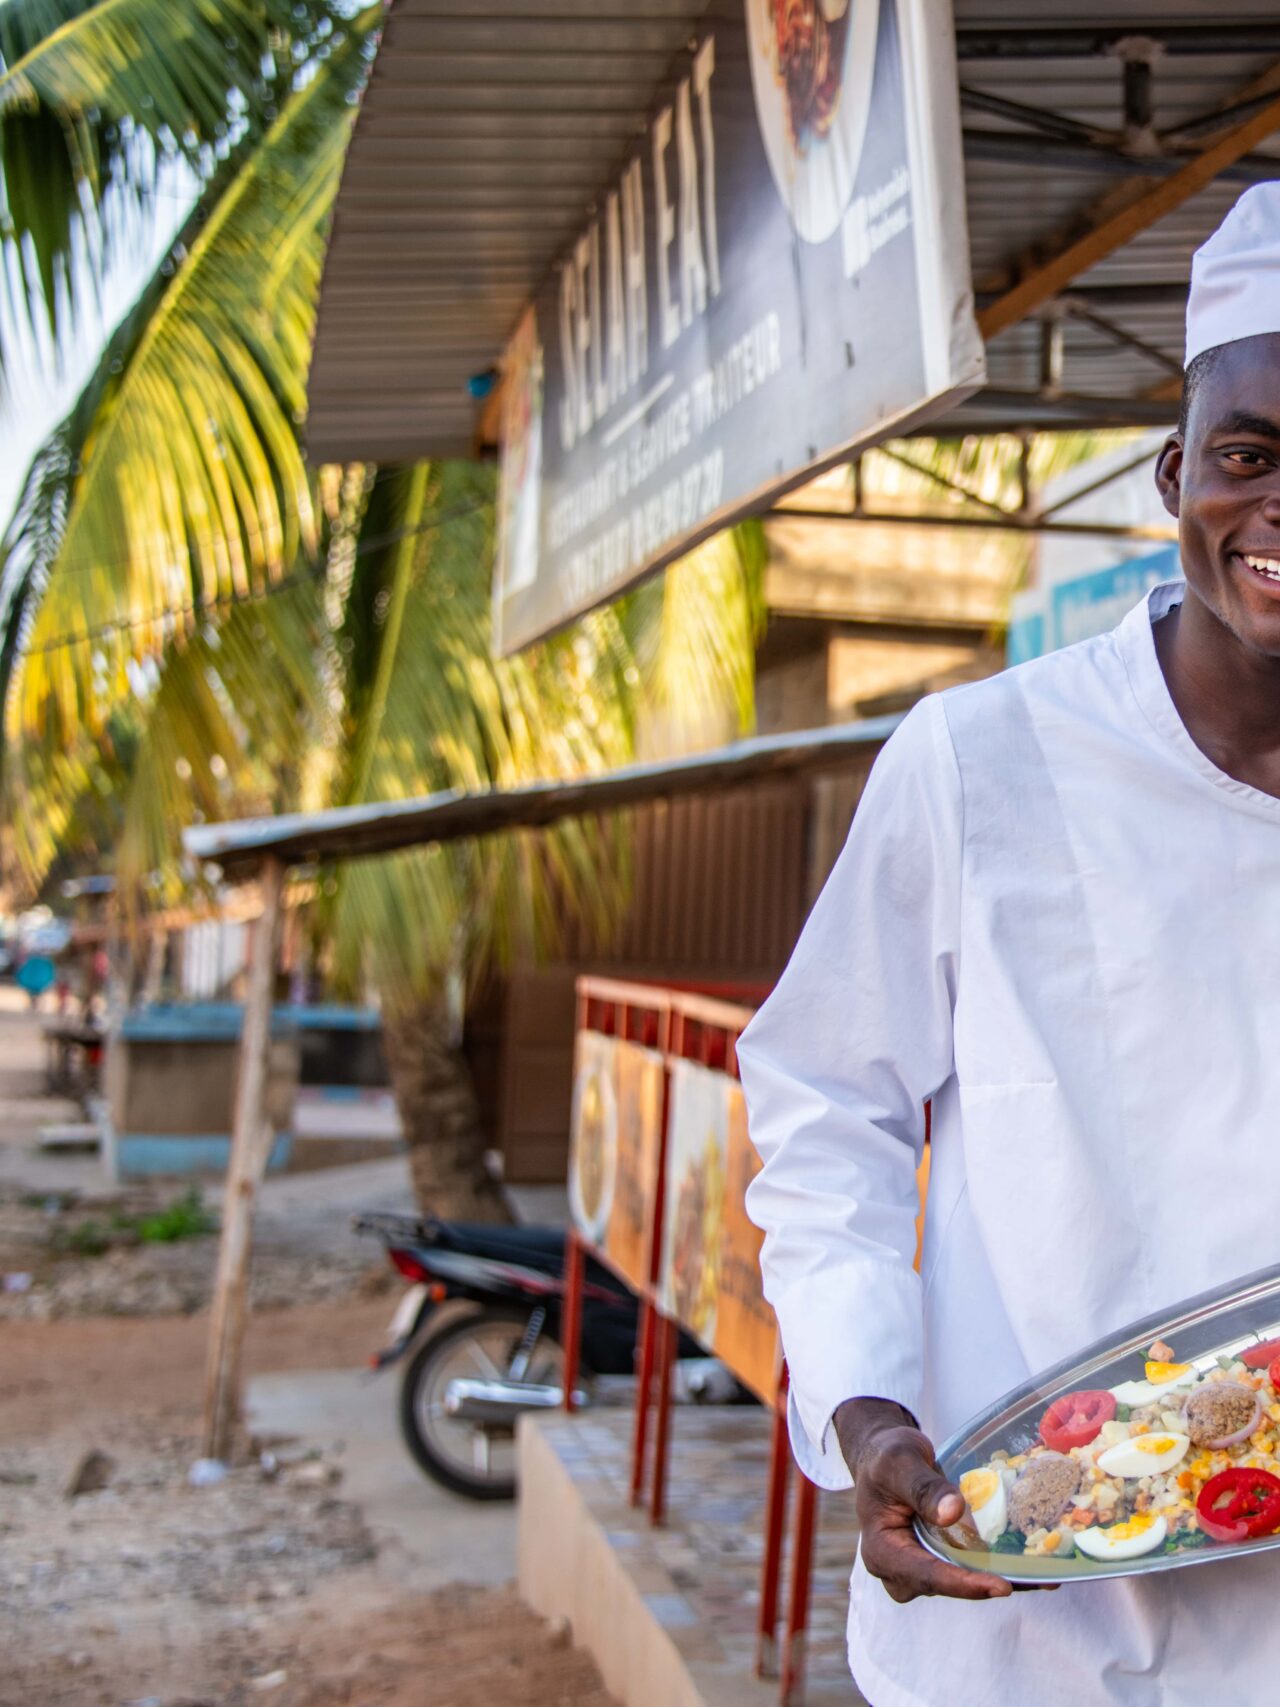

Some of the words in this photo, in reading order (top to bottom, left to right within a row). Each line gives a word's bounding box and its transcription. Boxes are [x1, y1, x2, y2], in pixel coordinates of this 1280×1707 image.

[559, 156, 649, 452] SELAH
[653, 34, 721, 350] EAT
[629, 390, 690, 489] SERVICE
[690, 309, 781, 436] TRAITEUR
